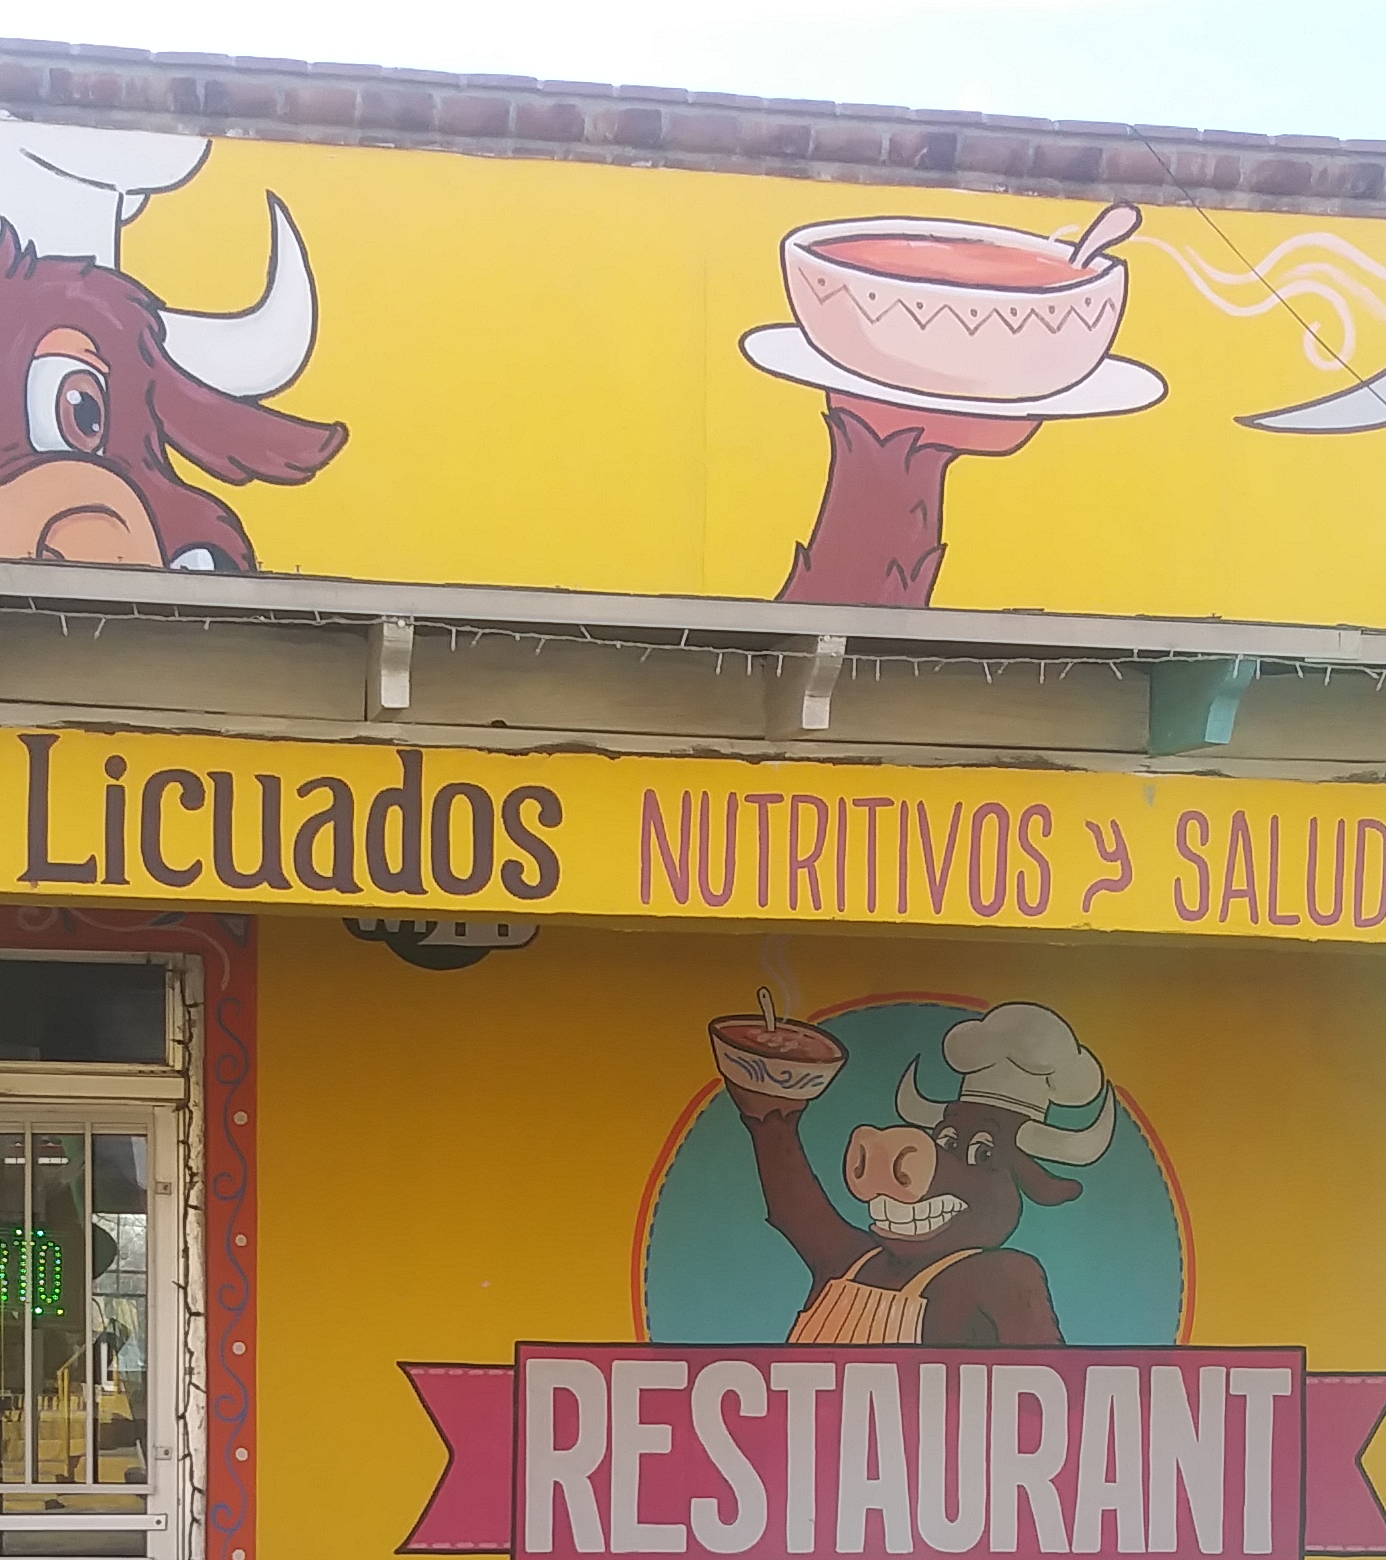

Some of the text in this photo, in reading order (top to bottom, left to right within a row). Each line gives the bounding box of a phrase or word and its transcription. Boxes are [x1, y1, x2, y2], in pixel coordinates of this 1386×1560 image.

[16, 733, 564, 900] Licuados
[639, 787, 1052, 919] NUTRITIVOS
[523, 1356, 1293, 1556] RESTAURANT
